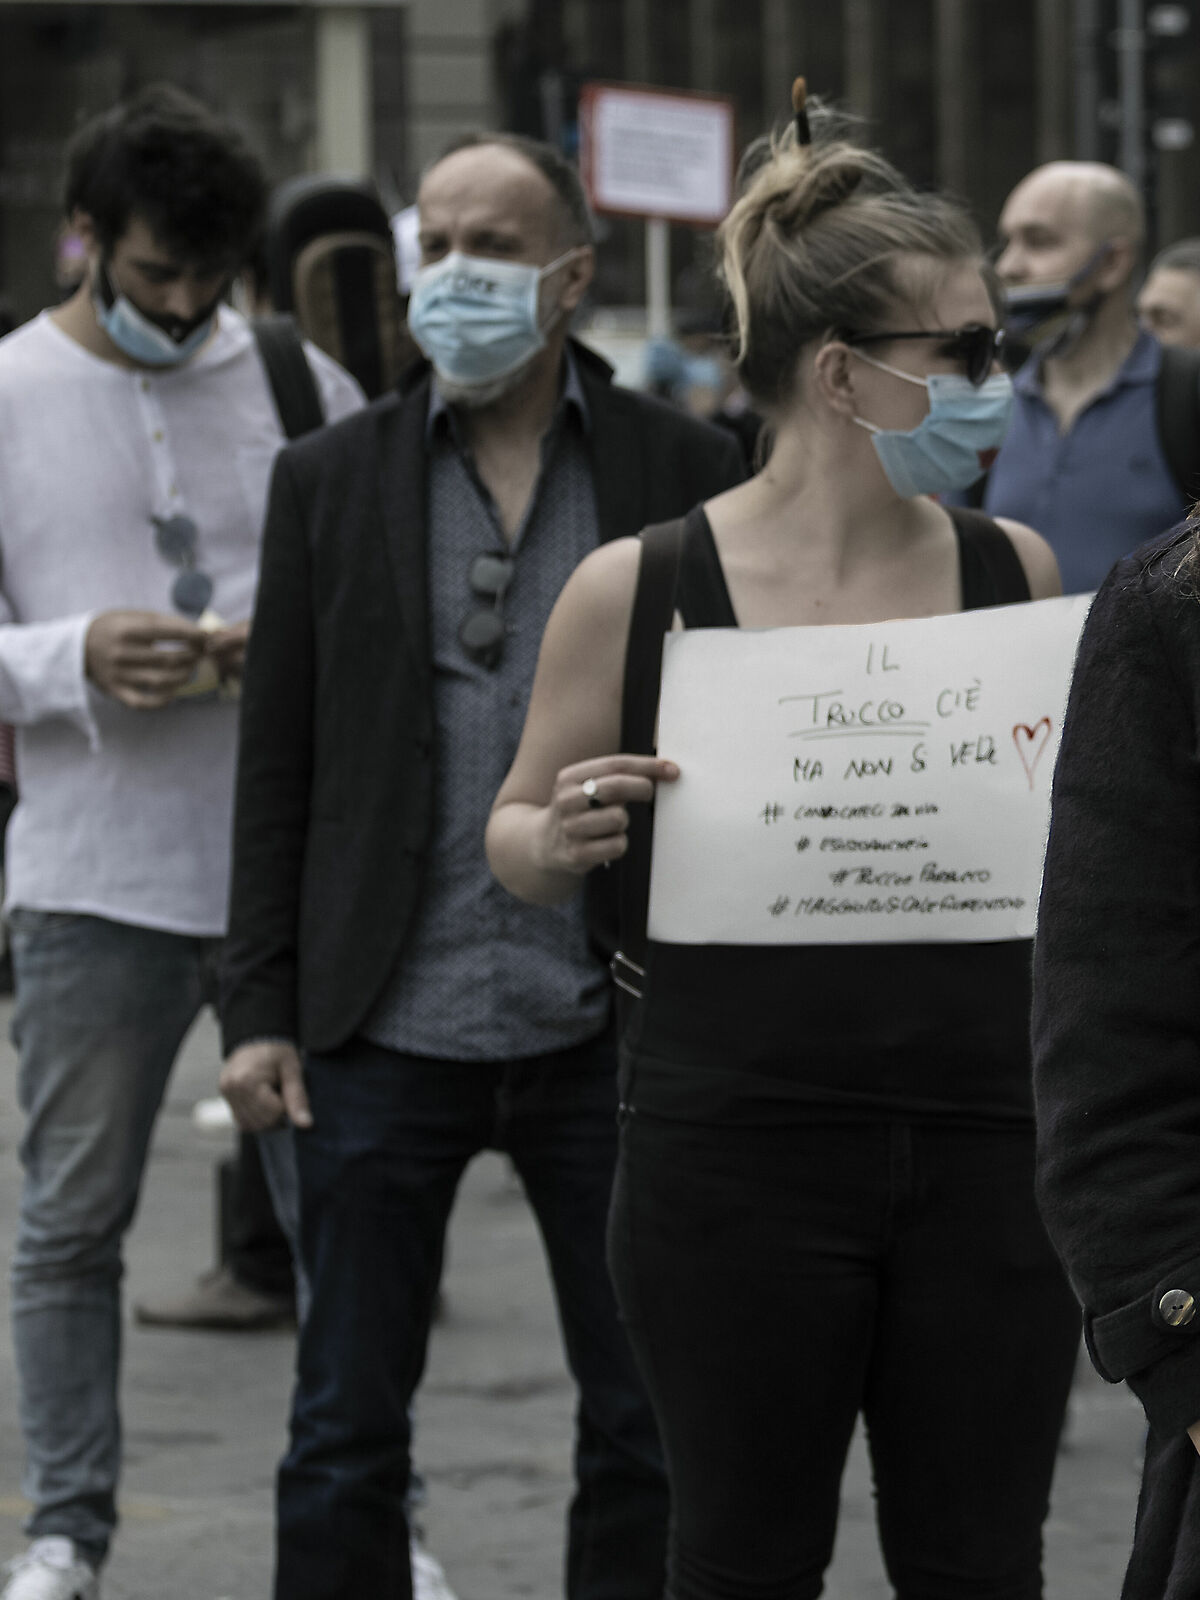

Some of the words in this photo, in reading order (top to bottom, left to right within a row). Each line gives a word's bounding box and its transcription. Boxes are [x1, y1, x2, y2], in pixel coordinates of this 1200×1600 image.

[865, 643, 900, 675] IL
[778, 689, 905, 727] TRUCCO
[793, 757, 823, 782] MA
[843, 757, 893, 781] NON
